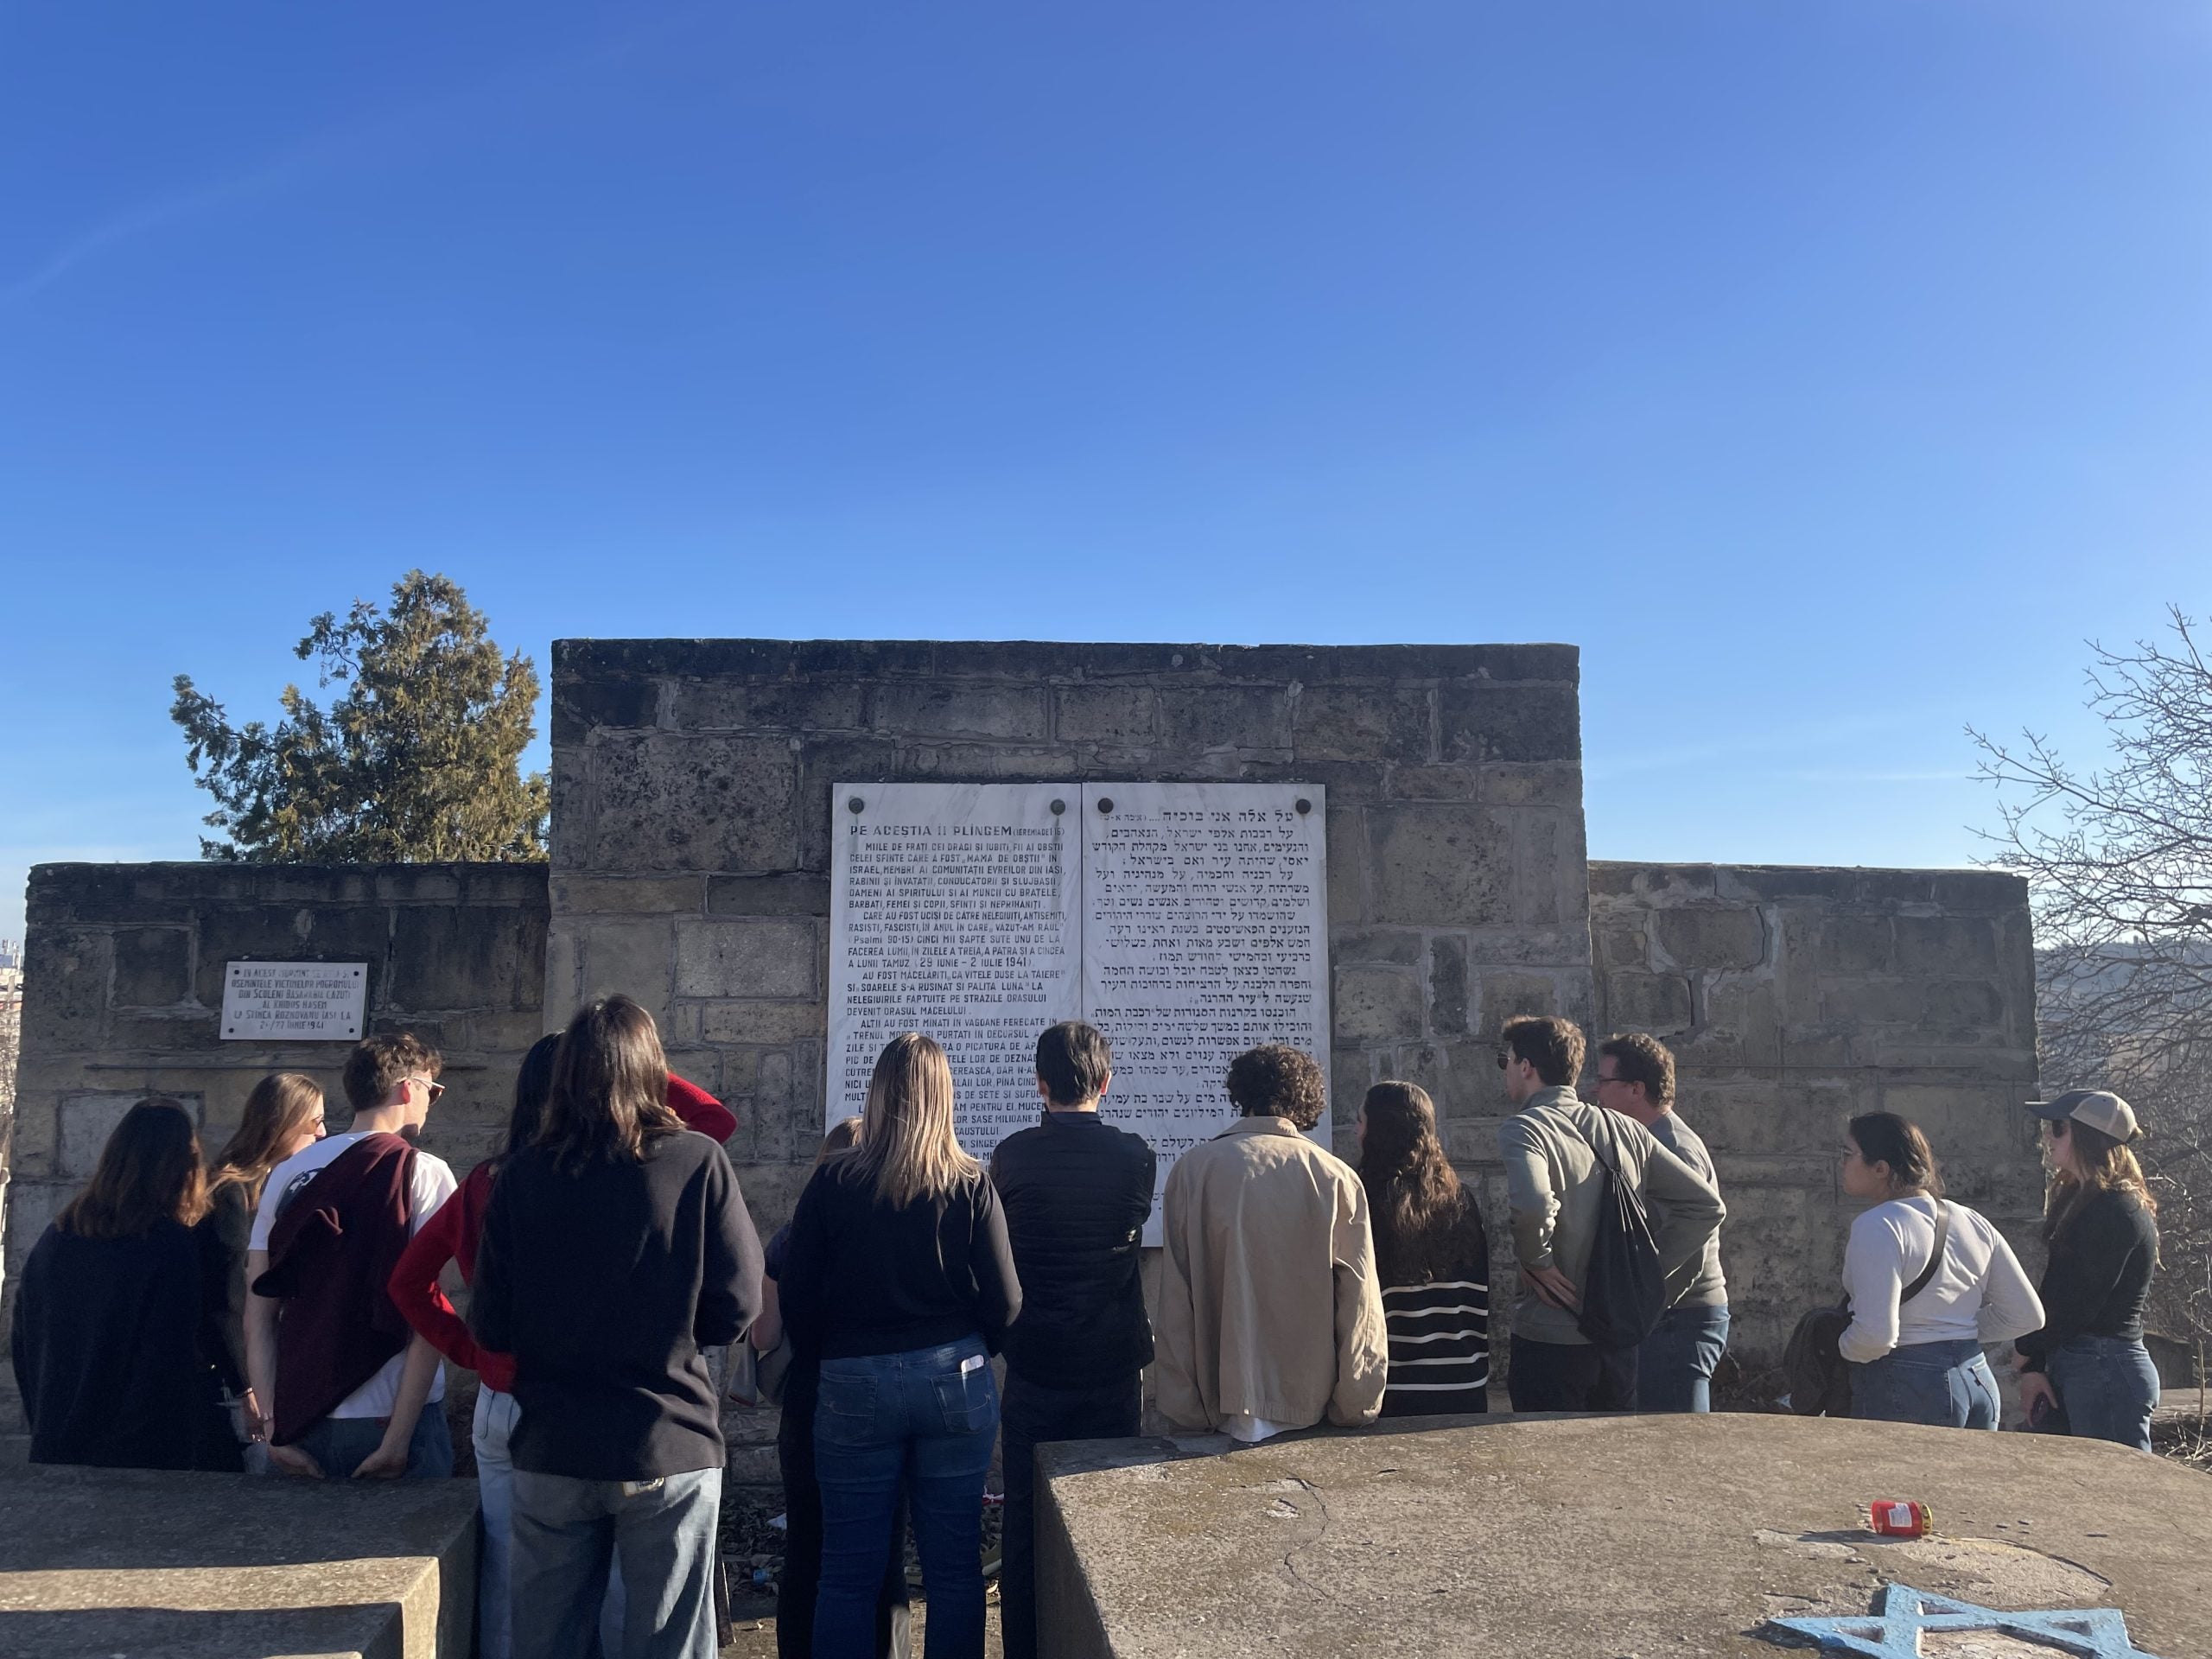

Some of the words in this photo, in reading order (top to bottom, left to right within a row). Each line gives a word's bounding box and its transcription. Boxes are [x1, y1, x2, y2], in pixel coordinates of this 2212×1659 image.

[1211, 812, 1230, 822] אני
[1239, 809, 1266, 822] אלה
[1275, 809, 1293, 822] על
[851, 826, 867, 836] PE
[1208, 826, 1234, 838] אלפי
[1279, 826, 1293, 839] על
[1092, 843, 1125, 854] הקודש
[1175, 840, 1207, 851] ישראל
[1214, 843, 1228, 851] בני
[998, 854, 1008, 862] DE
[1212, 857, 1231, 867] עיר
[1096, 867, 1114, 880] ועל
[1173, 867, 1186, 880] על
[1280, 864, 1293, 880] על
[864, 912, 882, 920] CARE
[886, 912, 896, 920] AU
[899, 912, 918, 920] FOST
[944, 912, 953, 920] DE
[1231, 908, 1244, 921] על
[1270, 926, 1310, 934] הגזענים
[943, 935, 955, 943] MII
[990, 935, 1011, 943] SUTE
[1015, 935, 1031, 943] UNU
[1035, 935, 1044, 943] DE
[1049, 935, 1060, 943] LA
[1187, 939, 1213, 947] מאות
[1217, 939, 1245, 947] ושבע
[1251, 936, 1283, 947] אלפים
[849, 947, 884, 956] FACEREA
[923, 947, 947, 955] ZILELE
[993, 947, 1017, 955] PATRA
[1277, 953, 1310, 962] ברביעי
[849, 960, 854, 968] A
[858, 960, 878, 968] LUNII
[882, 959, 909, 968] TAMUZ
[938, 958, 959, 967] IUNIE
[971, 957, 976, 967] 2
[981, 958, 1003, 967] IULIE
[1139, 967, 1169, 975] ובושה
[1174, 964, 1195, 975] יובל
[1233, 967, 1258, 976] כצאן
[863, 971, 874, 979] AU
[965, 970, 992, 979] VITELE
[995, 970, 1014, 979] DUSE
[1018, 970, 1028, 979] LA
[275, 980, 313, 988] VICTIMELOR
[316, 980, 359, 988] POGROMULUI
[1032, 982, 1043, 990] LA
[1226, 977, 1239, 990] על
[1243, 978, 1275, 989] הלבנה
[254, 989, 283, 998] SCULENI
[847, 995, 902, 1004] NELEGIUIRILE
[950, 995, 960, 1003] PE
[1275, 995, 1311, 1005] שנעשה
[847, 1007, 880, 1016] DEVENIT
[884, 1019, 895, 1028] AU
[899, 1019, 918, 1028] FOST
[965, 1018, 1000, 1026] VAGOANE
[1004, 1018, 1045, 1026] FERECATE
[1243, 1023, 1270, 1031] אותם
[1211, 1023, 1239, 1033] במשך
[987, 1030, 1029, 1038] DECURSUL
[1198, 1037, 1239, 1045] אפשרות
[1294, 1037, 1312, 1045] מים
[846, 1044, 864, 1052] ZILE
[846, 1056, 858, 1064] PIC
[864, 1055, 873, 1064] DE
[970, 1055, 985, 1063] LOR
[1129, 1051, 1154, 1060] מצאו
[845, 1080, 861, 1089] NICI
[965, 1091, 974, 1099] DE
[979, 1091, 999, 1099] SETE
[1177, 1090, 1191, 1104] על
[1196, 1094, 1215, 1103] מים
[970, 1103, 1002, 1111] PENTRU
[1136, 1109, 1168, 1117] יהודים
[996, 1115, 1032, 1123] MILIOANE
